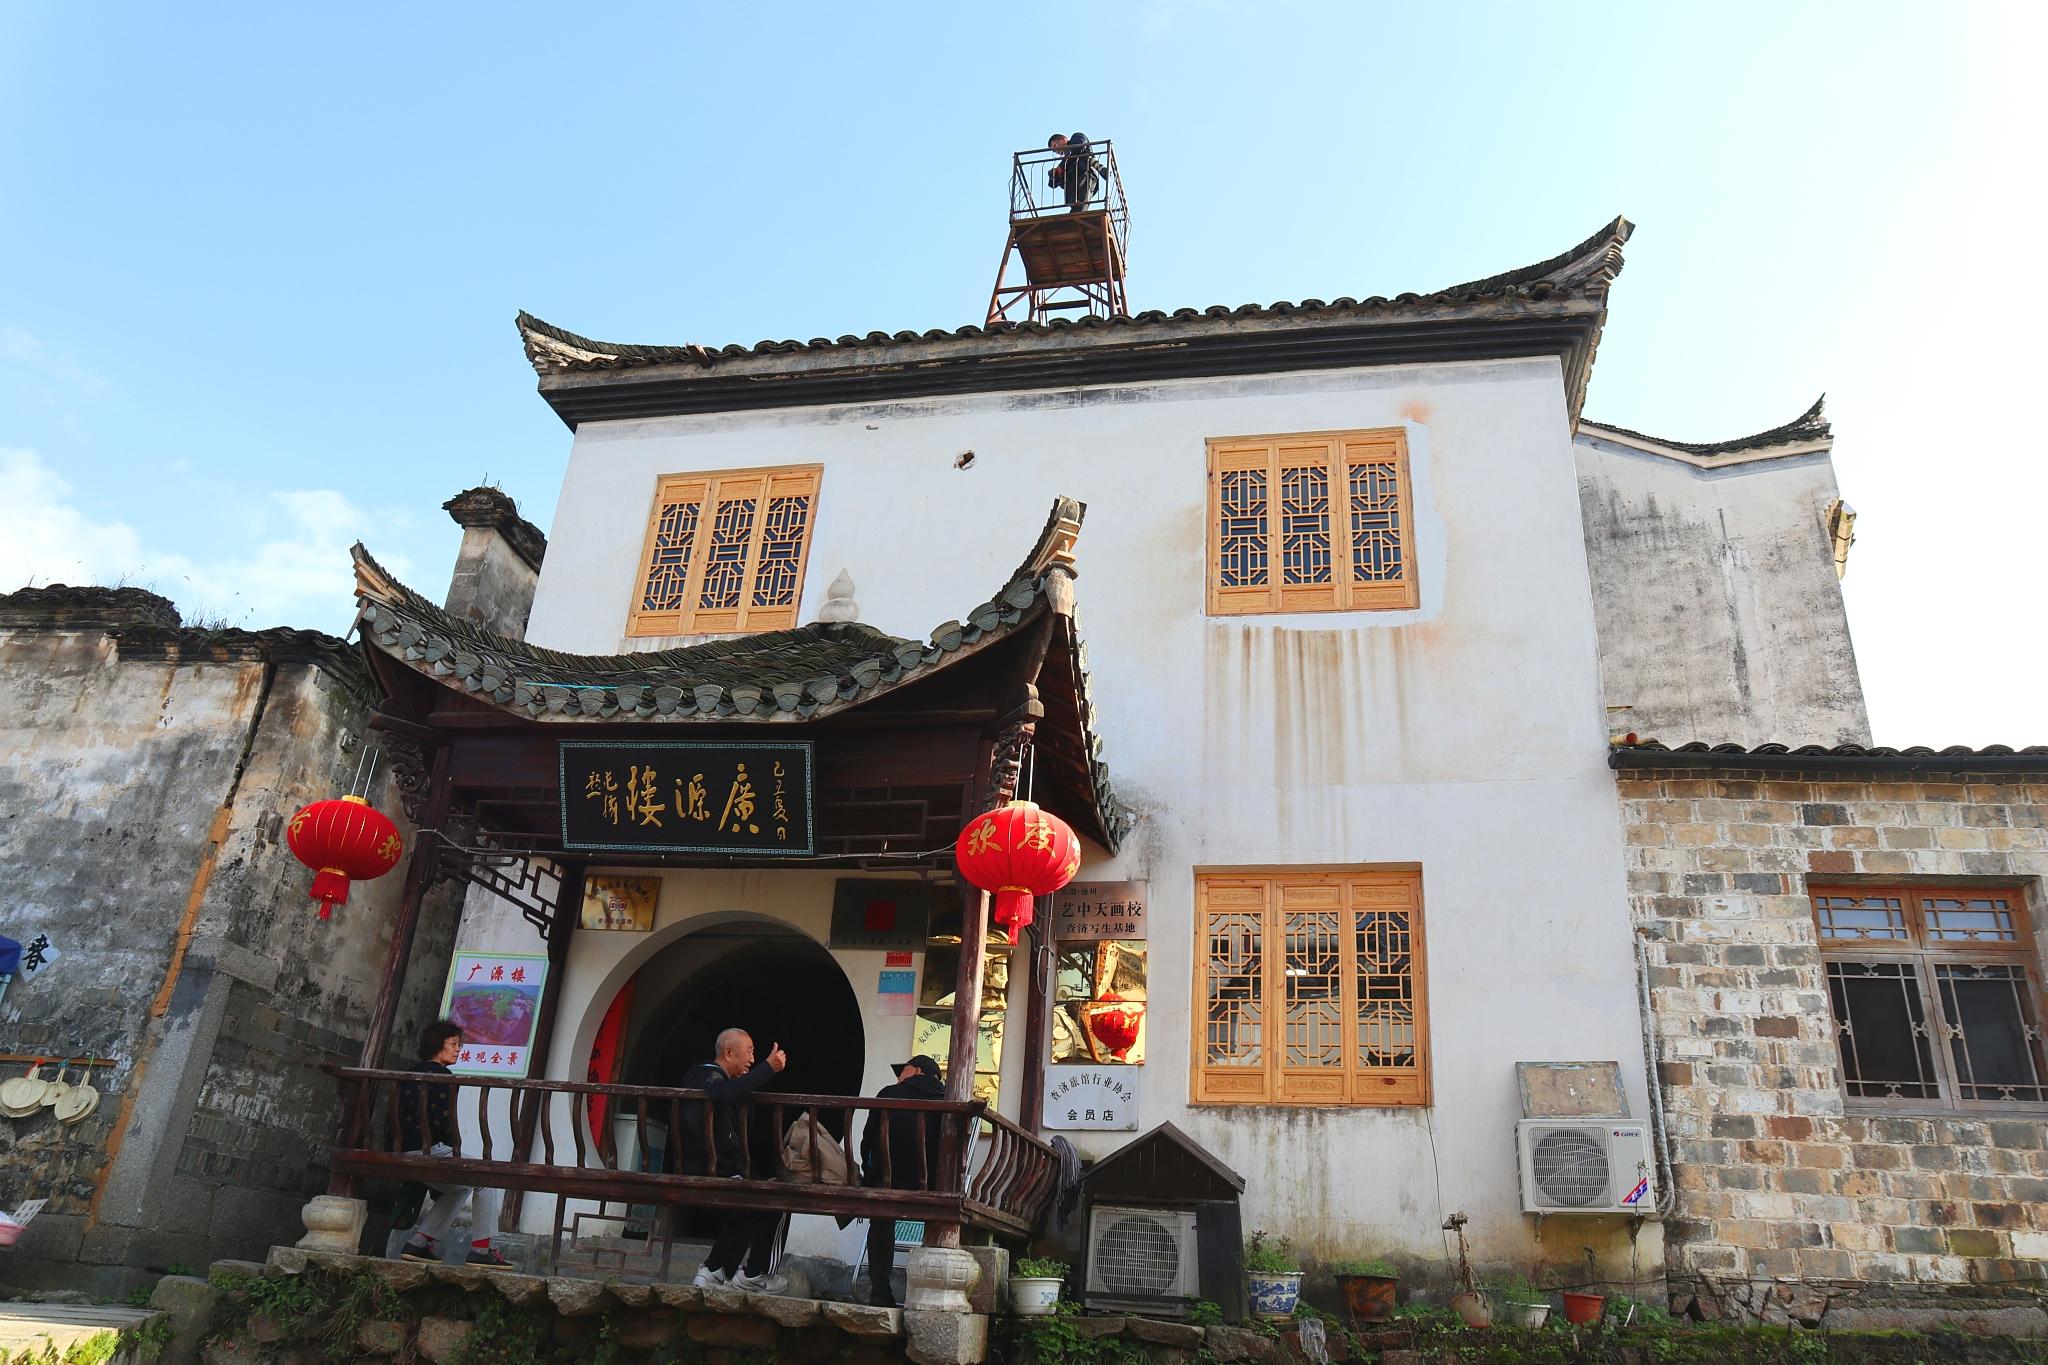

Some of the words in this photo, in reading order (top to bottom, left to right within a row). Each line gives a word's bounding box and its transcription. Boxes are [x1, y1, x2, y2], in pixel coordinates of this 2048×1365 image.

[1059, 900, 1143, 918] 艺中天画校
[1066, 922, 1137, 934] 查济写生基地
[466, 963, 526, 983] 广源楼
[455, 1049, 519, 1066] 楼观全景
[1050, 1072, 1132, 1103] 查济旅馆行业协会
[1067, 1109, 1114, 1122] 会员店
